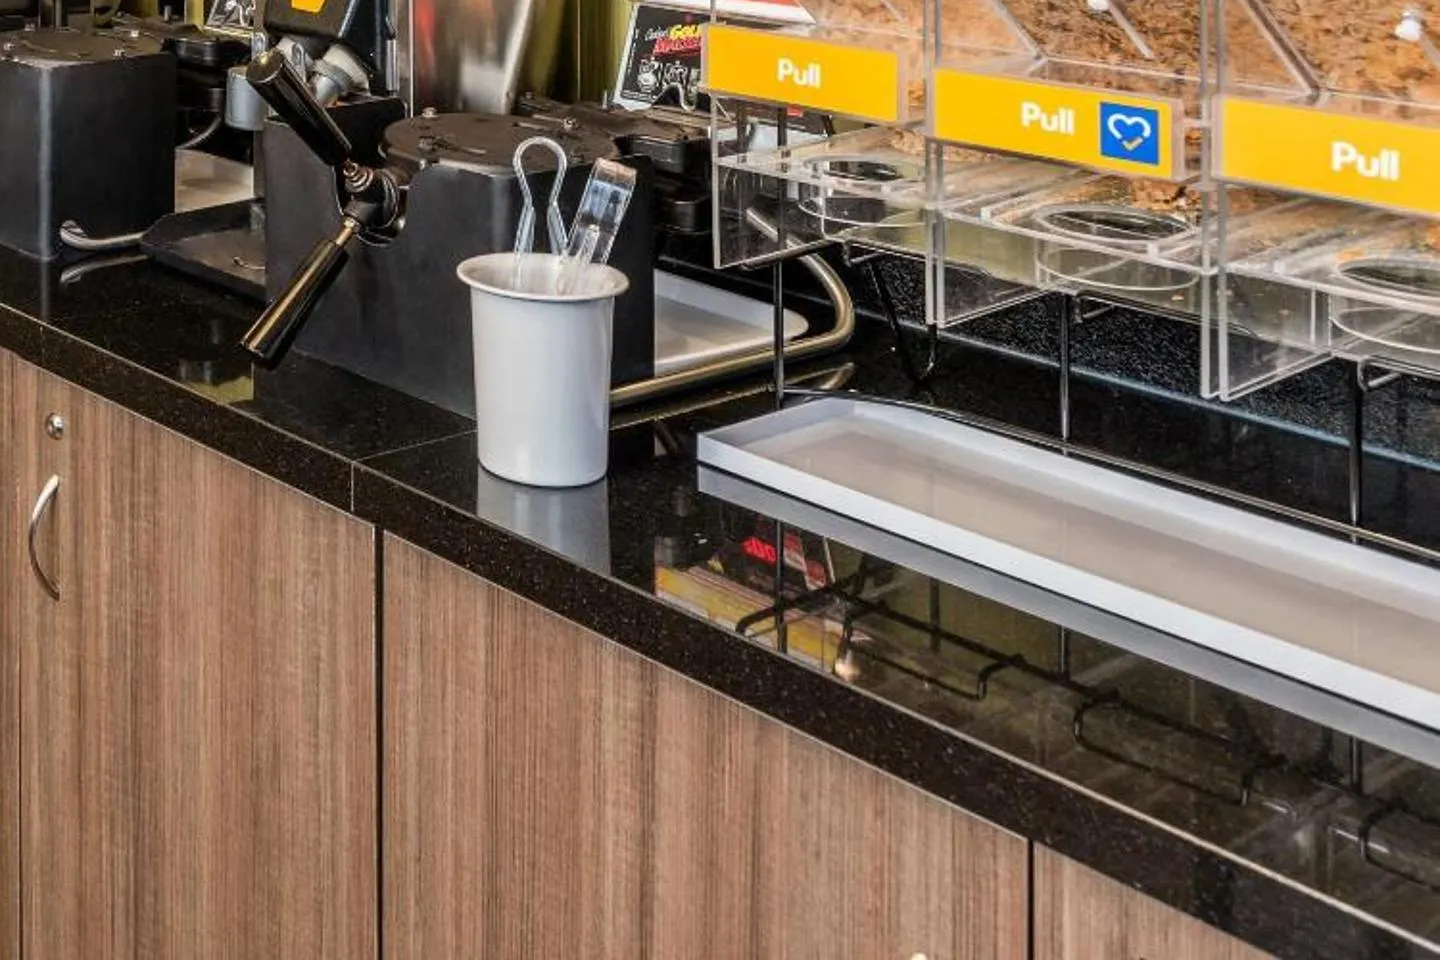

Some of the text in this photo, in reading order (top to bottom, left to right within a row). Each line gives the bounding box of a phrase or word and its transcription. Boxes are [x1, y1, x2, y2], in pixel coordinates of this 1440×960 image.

[777, 58, 821, 88] Pull
[1021, 101, 1075, 135] Pull
[1331, 140, 1400, 181] Pull
